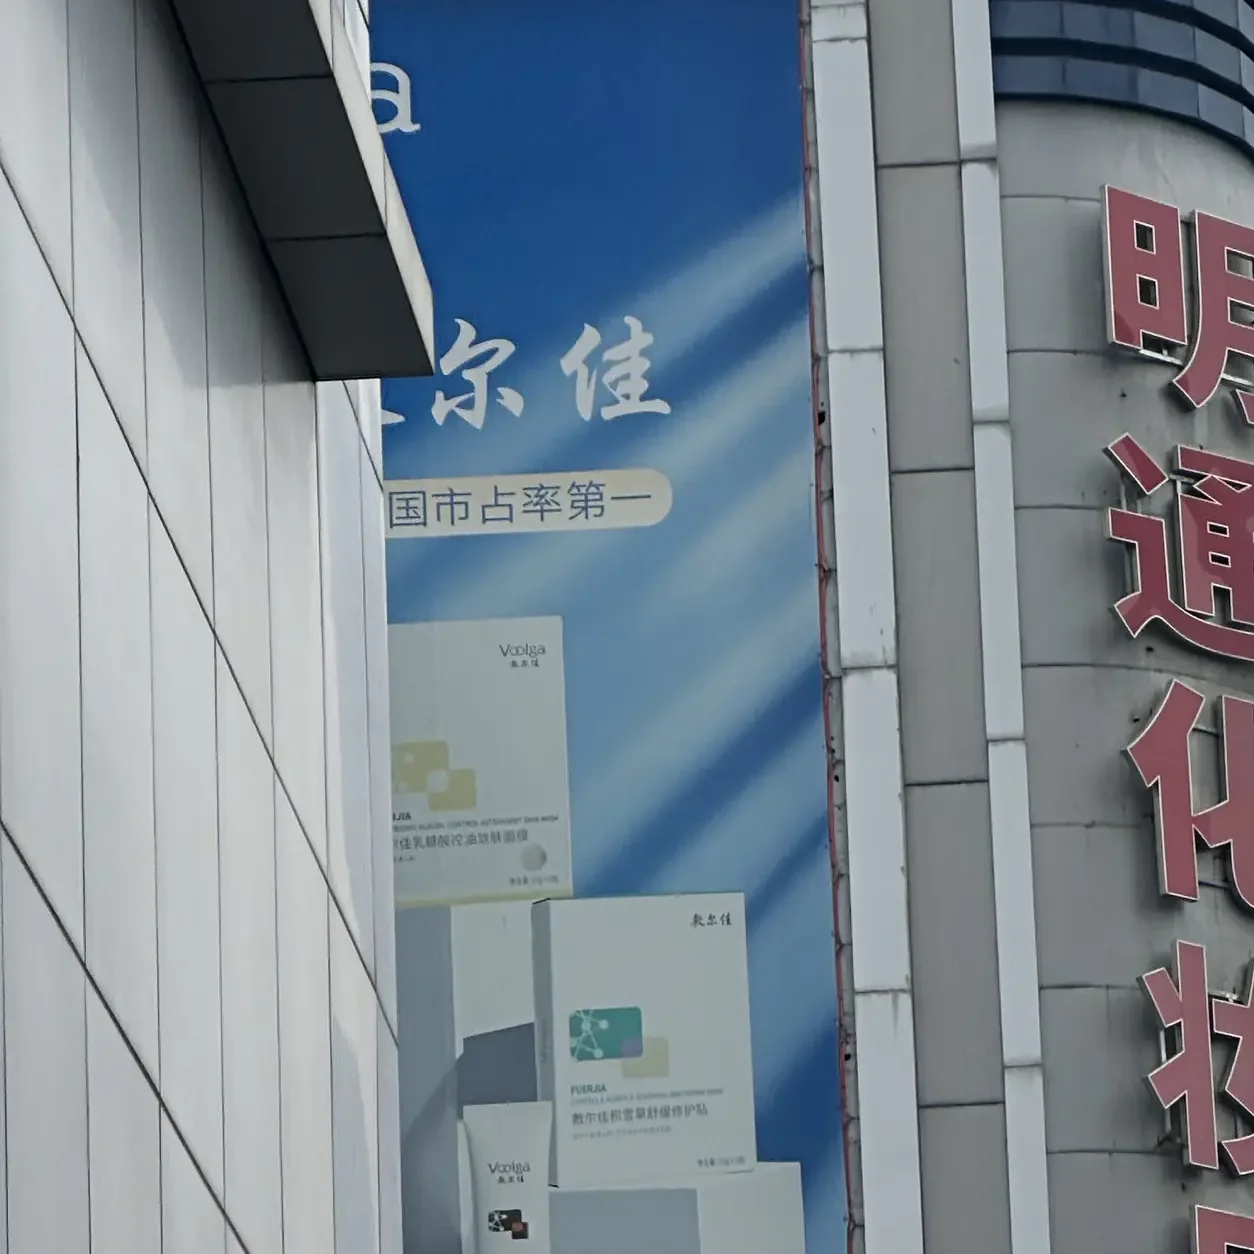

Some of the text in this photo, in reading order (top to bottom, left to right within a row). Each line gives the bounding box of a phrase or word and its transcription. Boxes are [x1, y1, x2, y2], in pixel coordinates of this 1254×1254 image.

[381, 315, 671, 430] 尔佳
[388, 480, 652, 530] 国市占率第一
